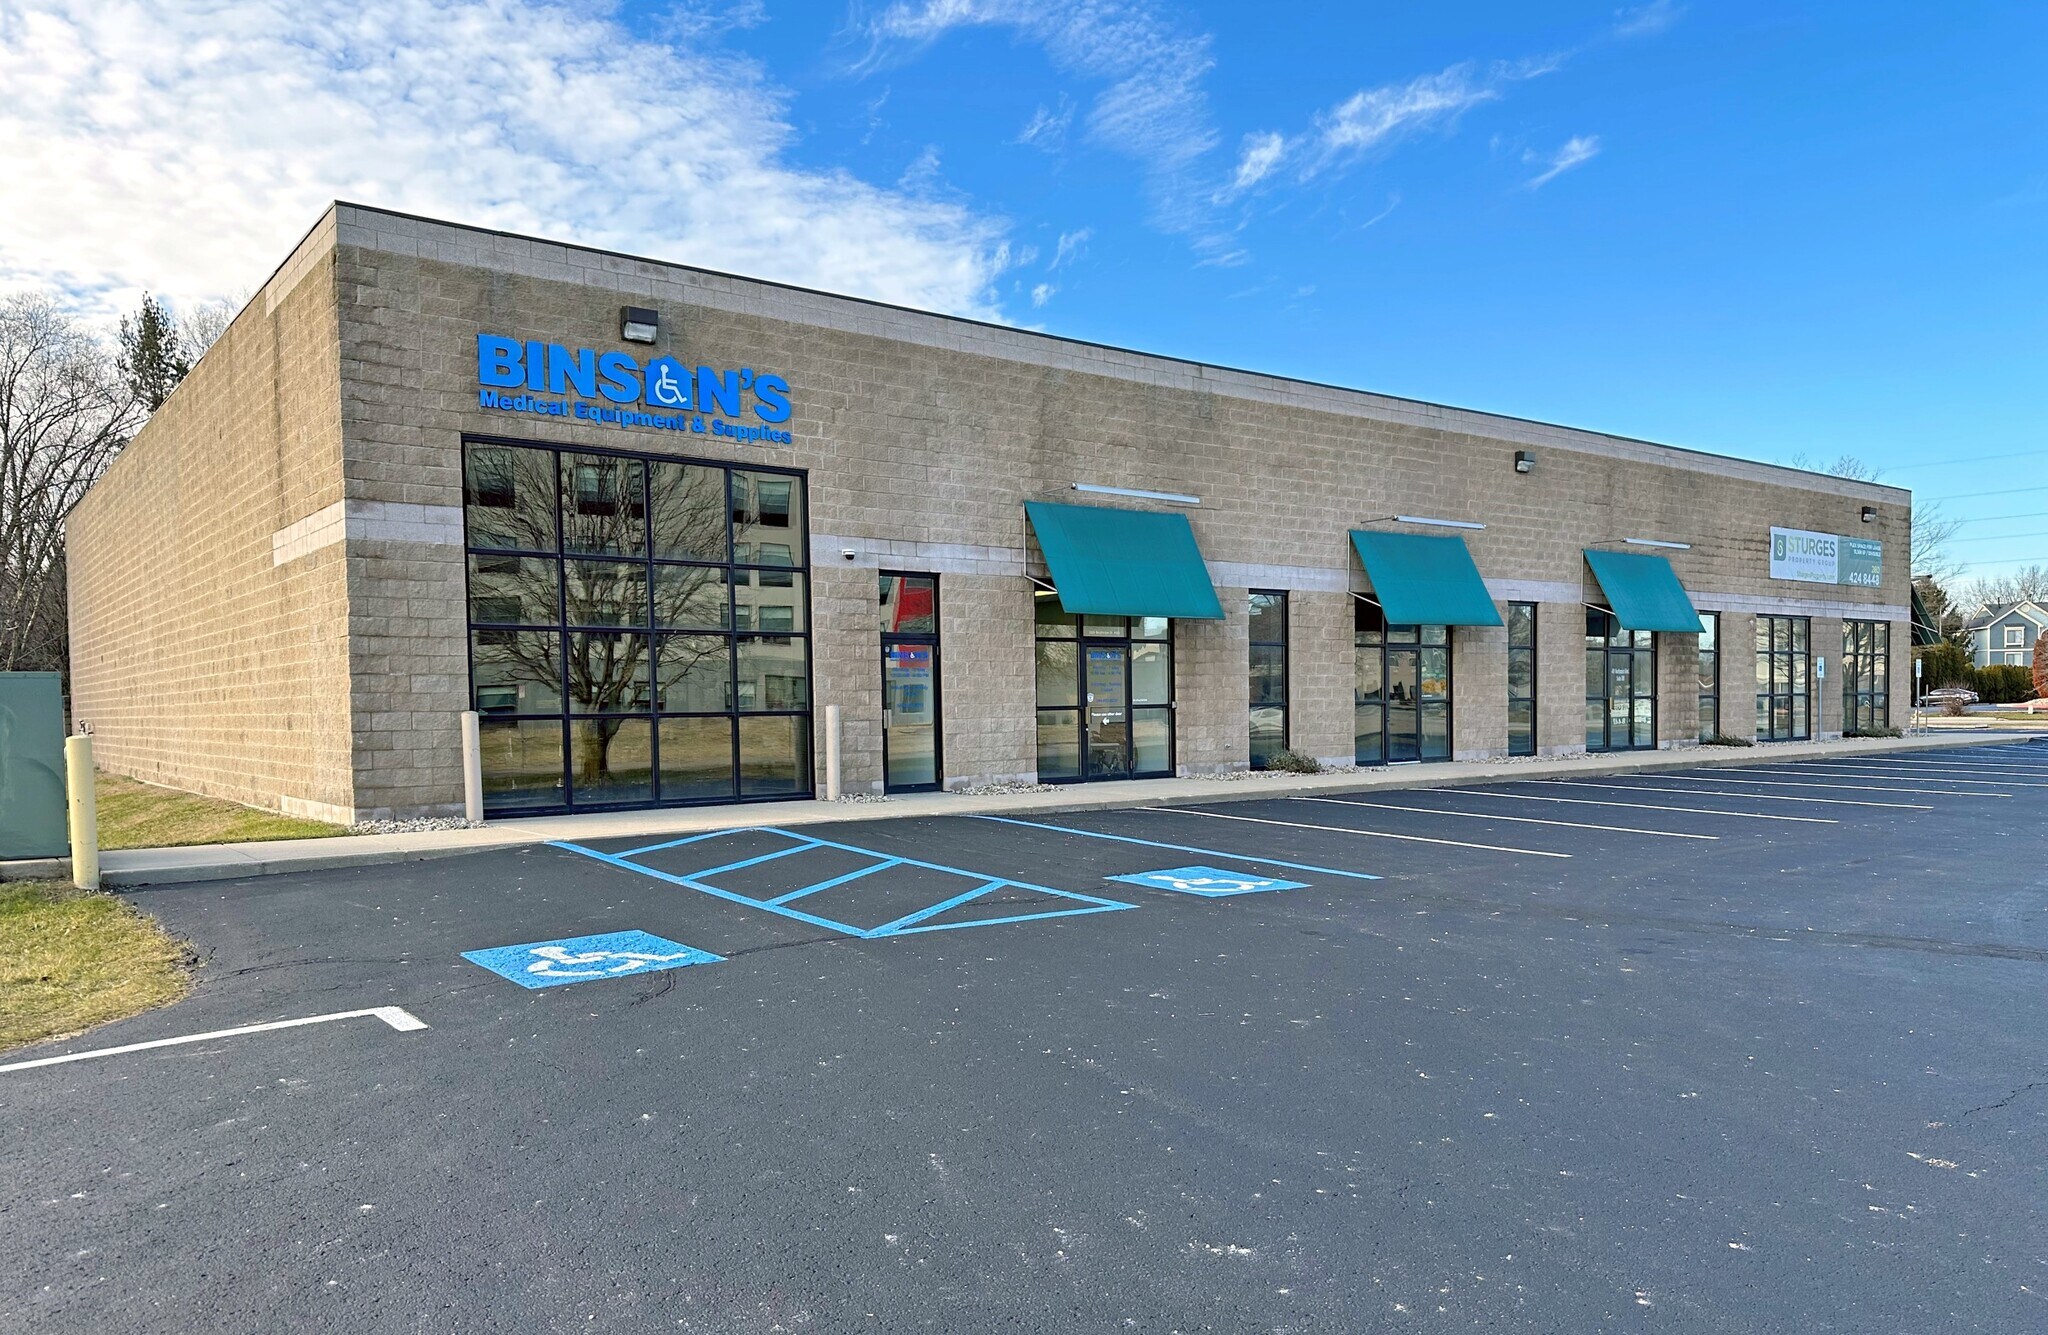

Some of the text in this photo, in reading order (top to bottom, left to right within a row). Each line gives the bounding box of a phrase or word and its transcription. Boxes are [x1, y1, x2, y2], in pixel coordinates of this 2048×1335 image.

[477, 333, 792, 423] BINSN'S
[478, 389, 792, 445] Medical Equipment & Supplies
[1788, 536, 1836, 557] STURGES
[1788, 556, 1835, 567] PROPERTY GROUP
[1849, 571, 1862, 584] 424
